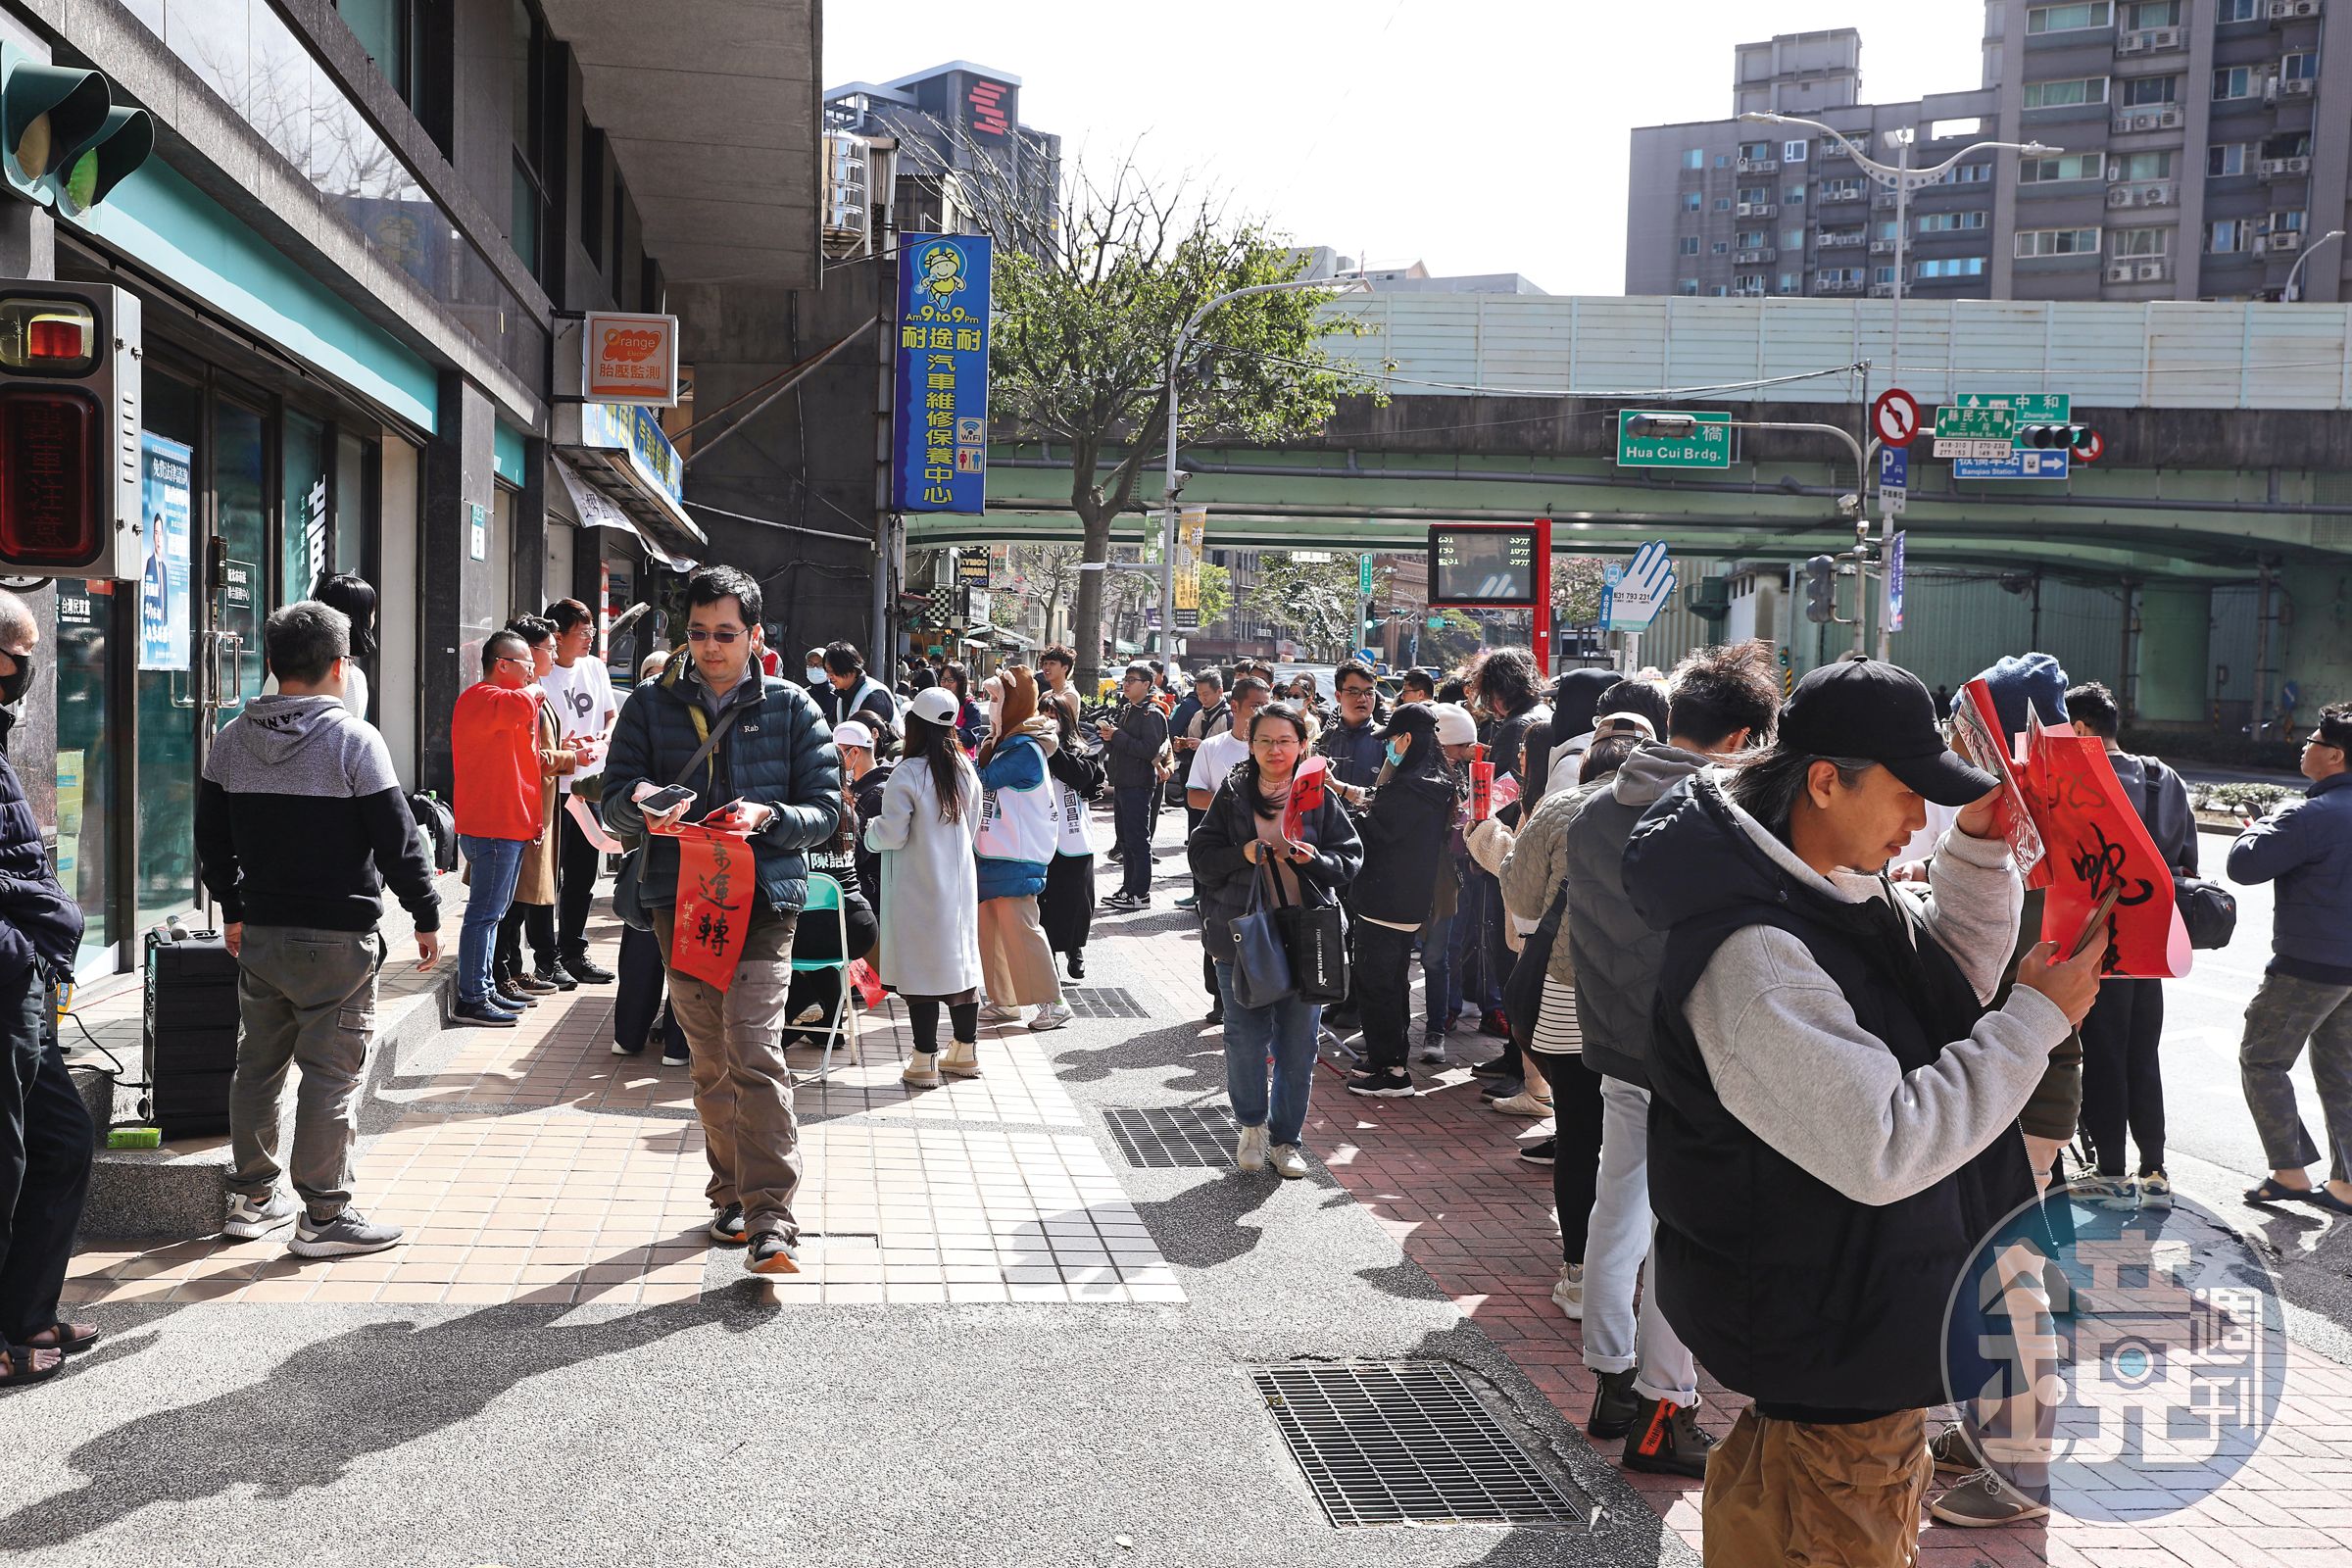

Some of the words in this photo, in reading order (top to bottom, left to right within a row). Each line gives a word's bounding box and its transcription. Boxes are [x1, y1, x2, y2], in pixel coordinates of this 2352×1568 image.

[902, 325, 982, 352] 耐途耐
[600, 363, 662, 380] 胎壓監測
[2015, 394, 2060, 411] 中和
[1947, 409, 2005, 423] 縣民大道
[923, 354, 956, 504] 汽車維修保養中心
[1626, 447, 1653, 458] Hua
[1657, 447, 1681, 459] Cui
[1684, 448, 1722, 462] Brdg.
[1882, 450, 1894, 474] P
[744, 724, 760, 733] Rab
